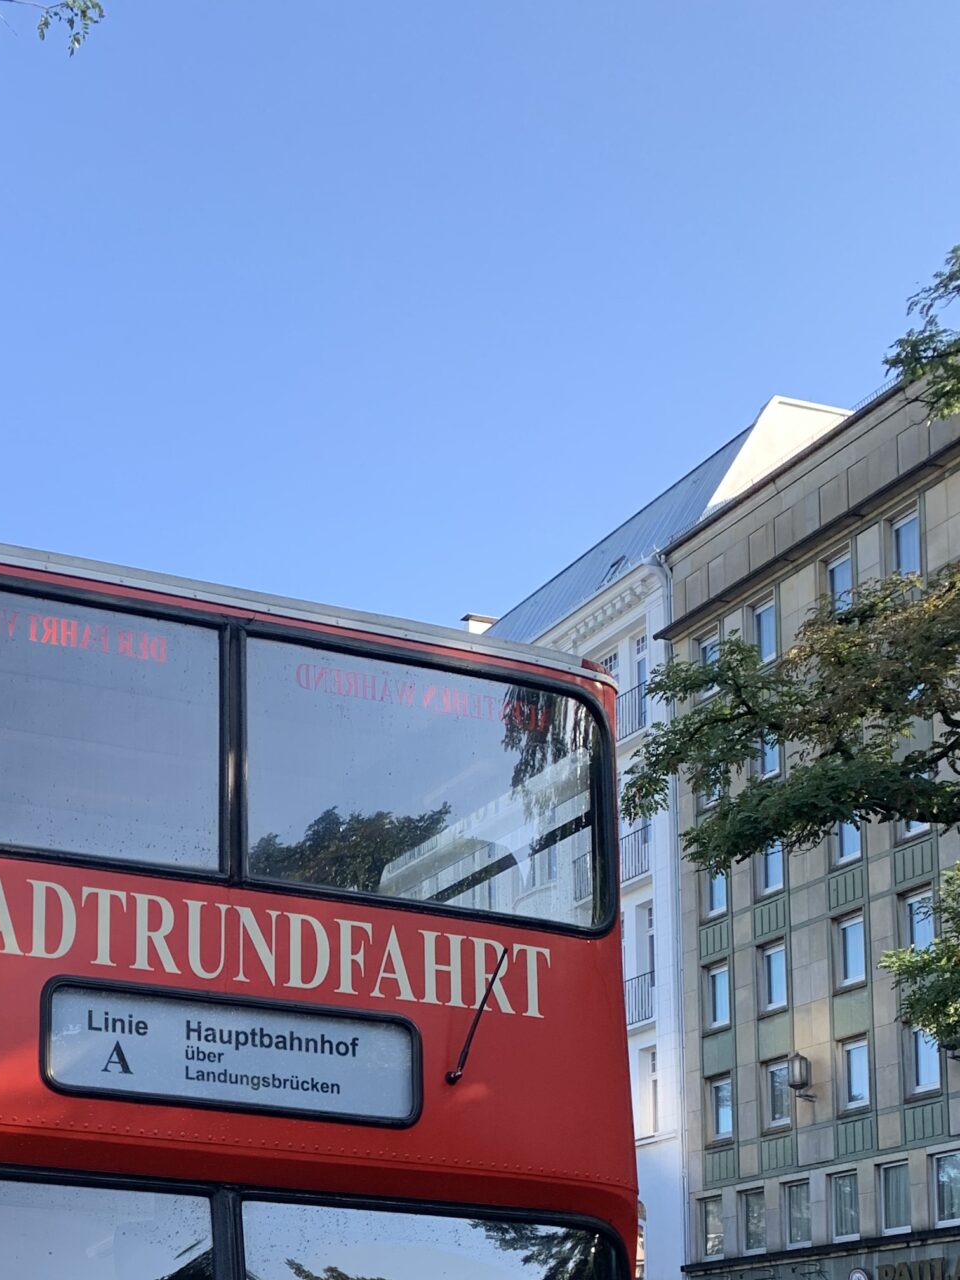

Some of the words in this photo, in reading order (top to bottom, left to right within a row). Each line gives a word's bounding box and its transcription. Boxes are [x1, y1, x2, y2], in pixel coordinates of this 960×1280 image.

[87, 1009, 149, 1037] Linie
[185, 1019, 360, 1057] Hauptbahnhof
[101, 1040, 133, 1075] A
[185, 1045, 224, 1064] über
[184, 1065, 341, 1095] Landungsbrücken
